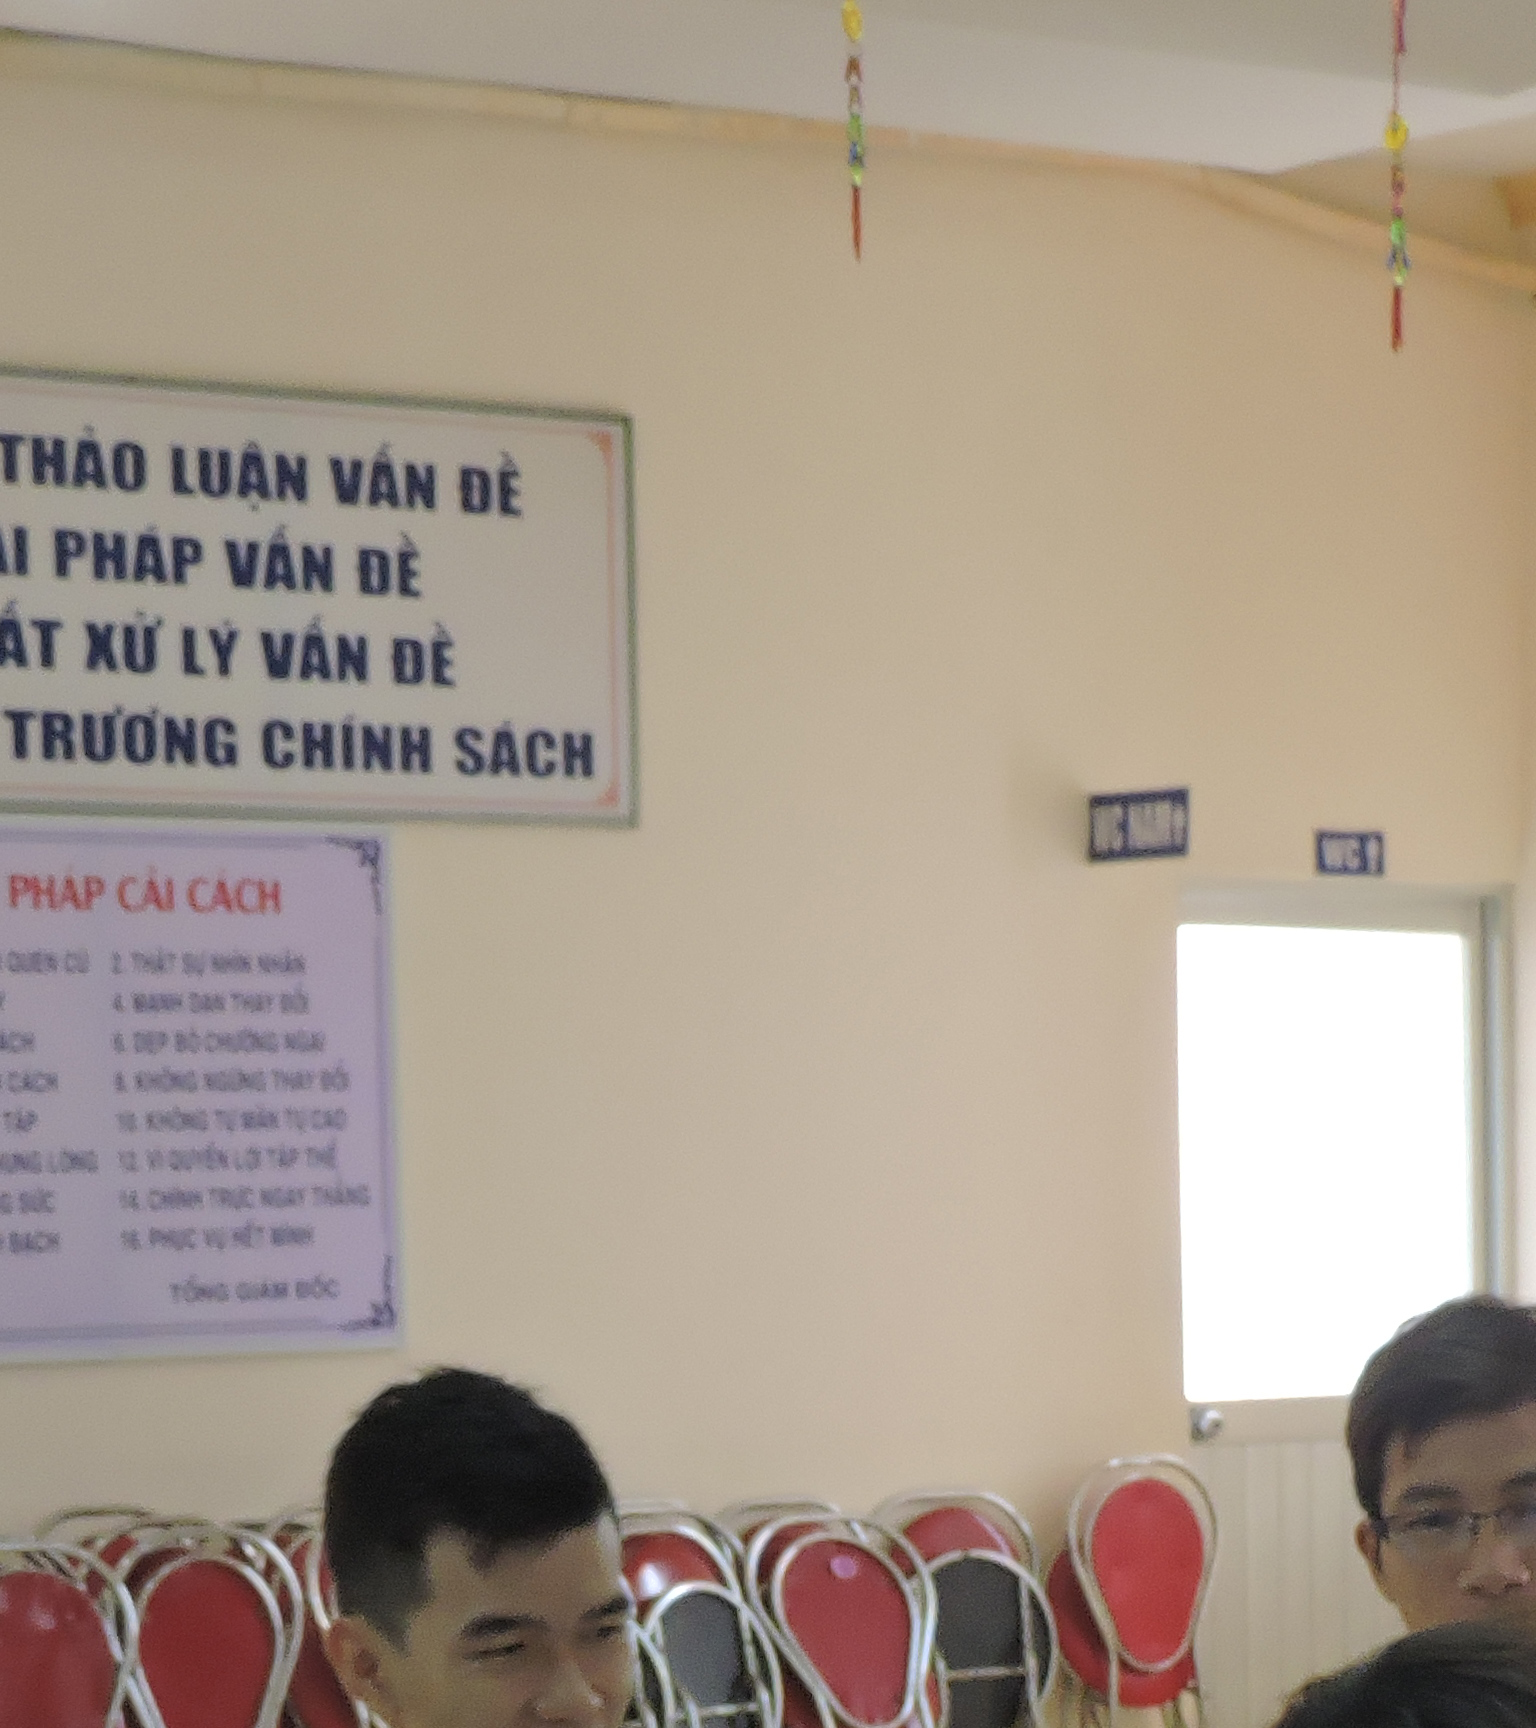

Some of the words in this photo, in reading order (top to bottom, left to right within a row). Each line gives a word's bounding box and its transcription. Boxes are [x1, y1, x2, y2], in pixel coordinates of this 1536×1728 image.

[171, 440, 309, 513] LUẬN
[330, 441, 438, 511] VẤN
[459, 450, 524, 518] ĐỀ
[53, 522, 204, 586] PHÁP
[224, 523, 335, 593] VẤN
[357, 530, 423, 600] ĐỀ
[84, 609, 163, 674] XỬ
[181, 618, 240, 677] LÝ
[261, 613, 370, 685] VẤN
[391, 620, 456, 688] ĐỀ
[3, 703, 239, 768] TRƯƠNG
[261, 712, 434, 775] CHÍNH
[454, 720, 595, 780] SÁCH
[7, 864, 106, 913] PHÁP
[117, 865, 176, 913] CẢI
[186, 866, 282, 915] CÁCH
